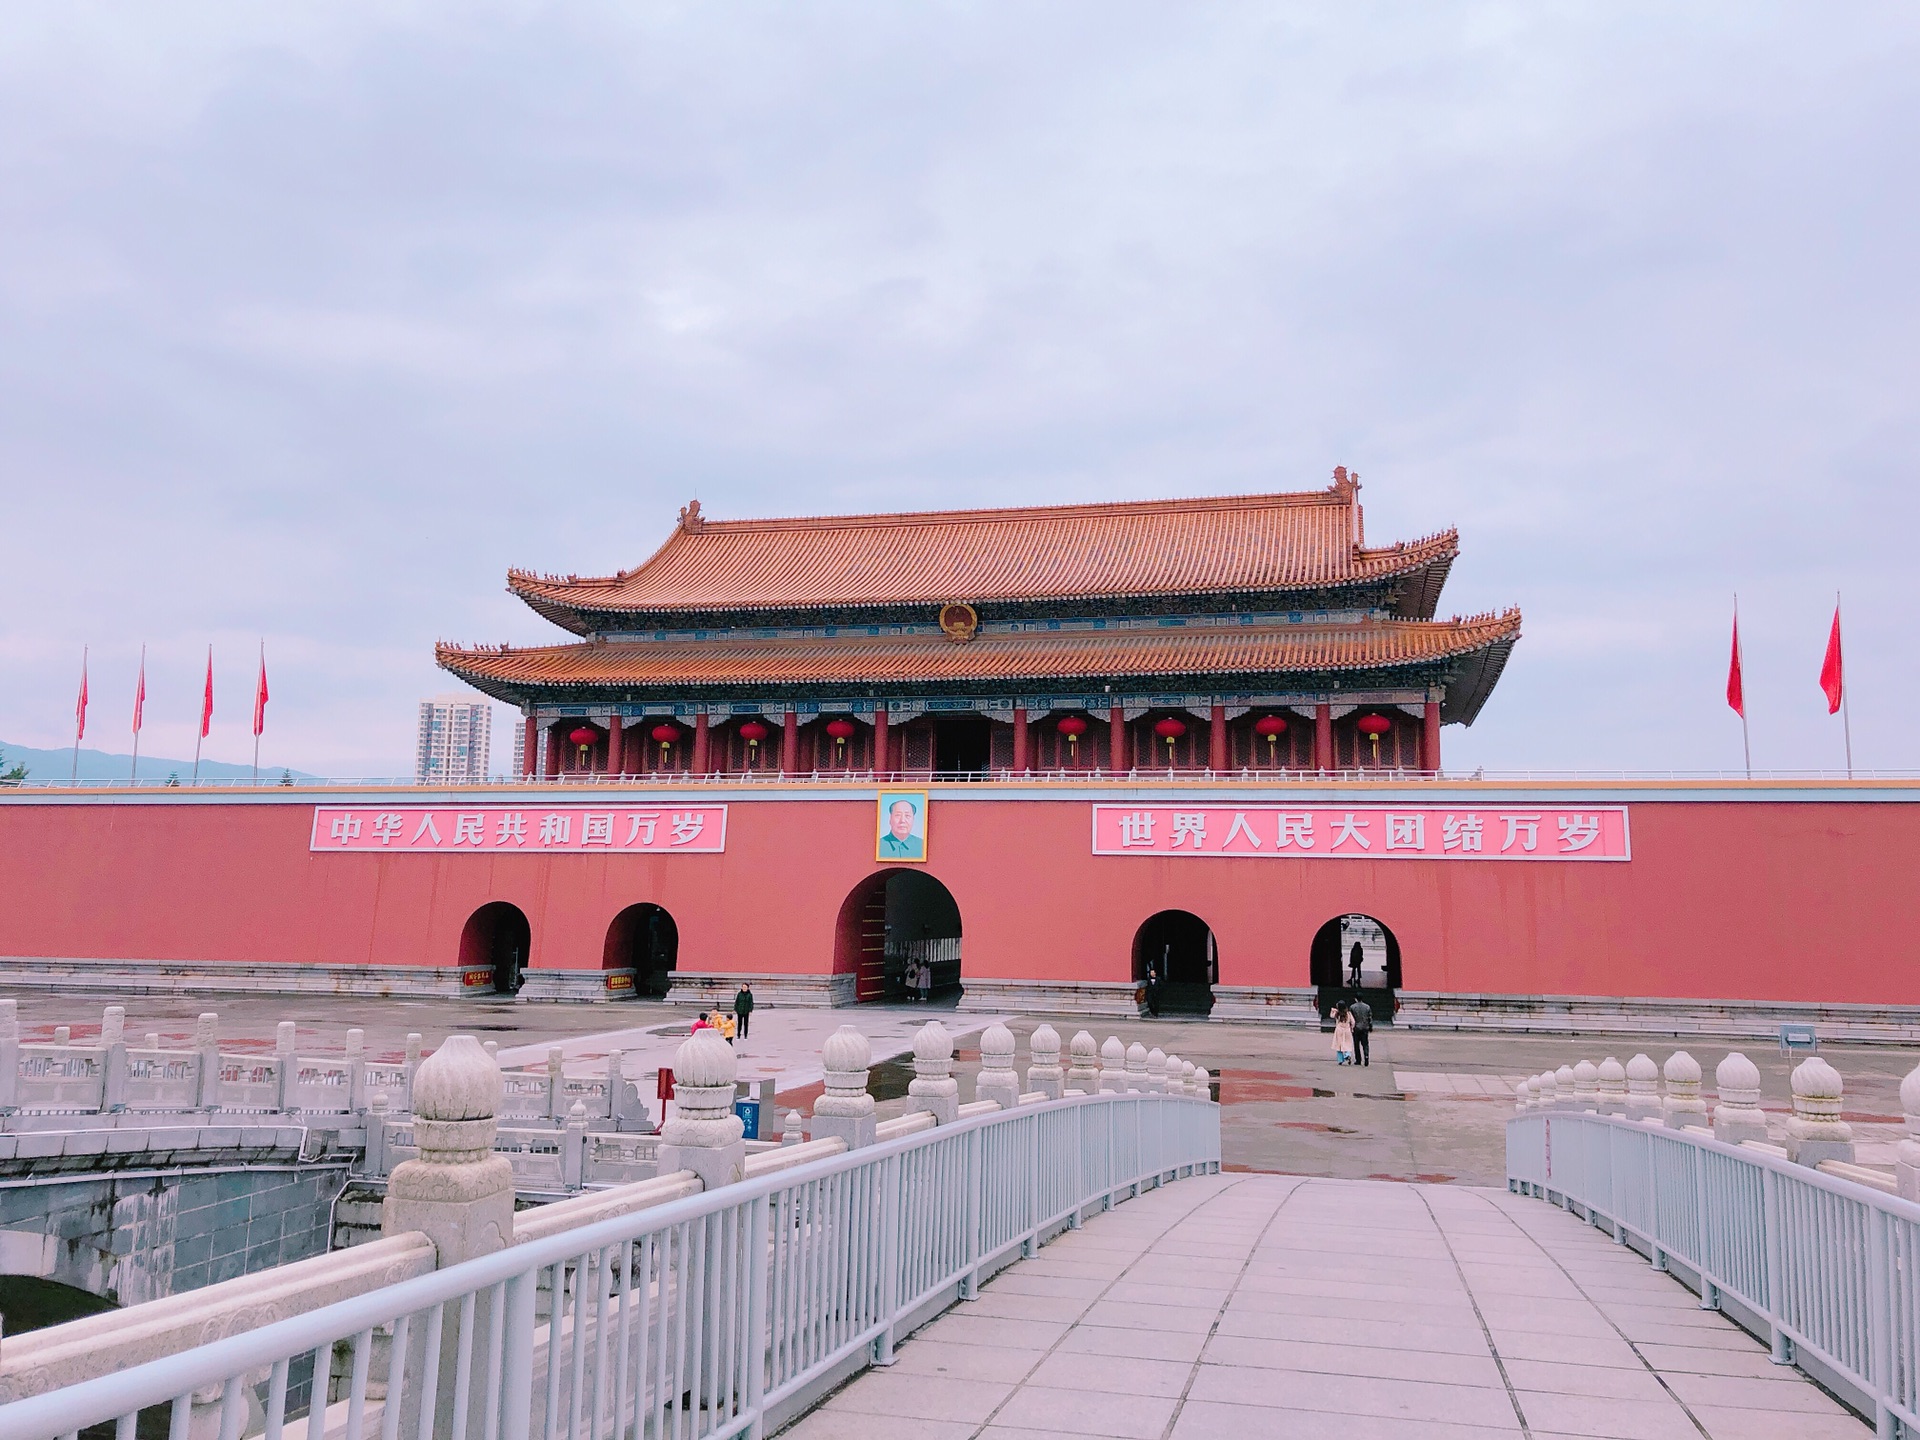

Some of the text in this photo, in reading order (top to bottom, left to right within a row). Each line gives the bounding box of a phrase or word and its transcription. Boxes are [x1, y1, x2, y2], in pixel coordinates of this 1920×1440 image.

[331, 813, 704, 845] 中华人民共和国万岁
[1119, 813, 1601, 852] 世界人民大团结万岁
